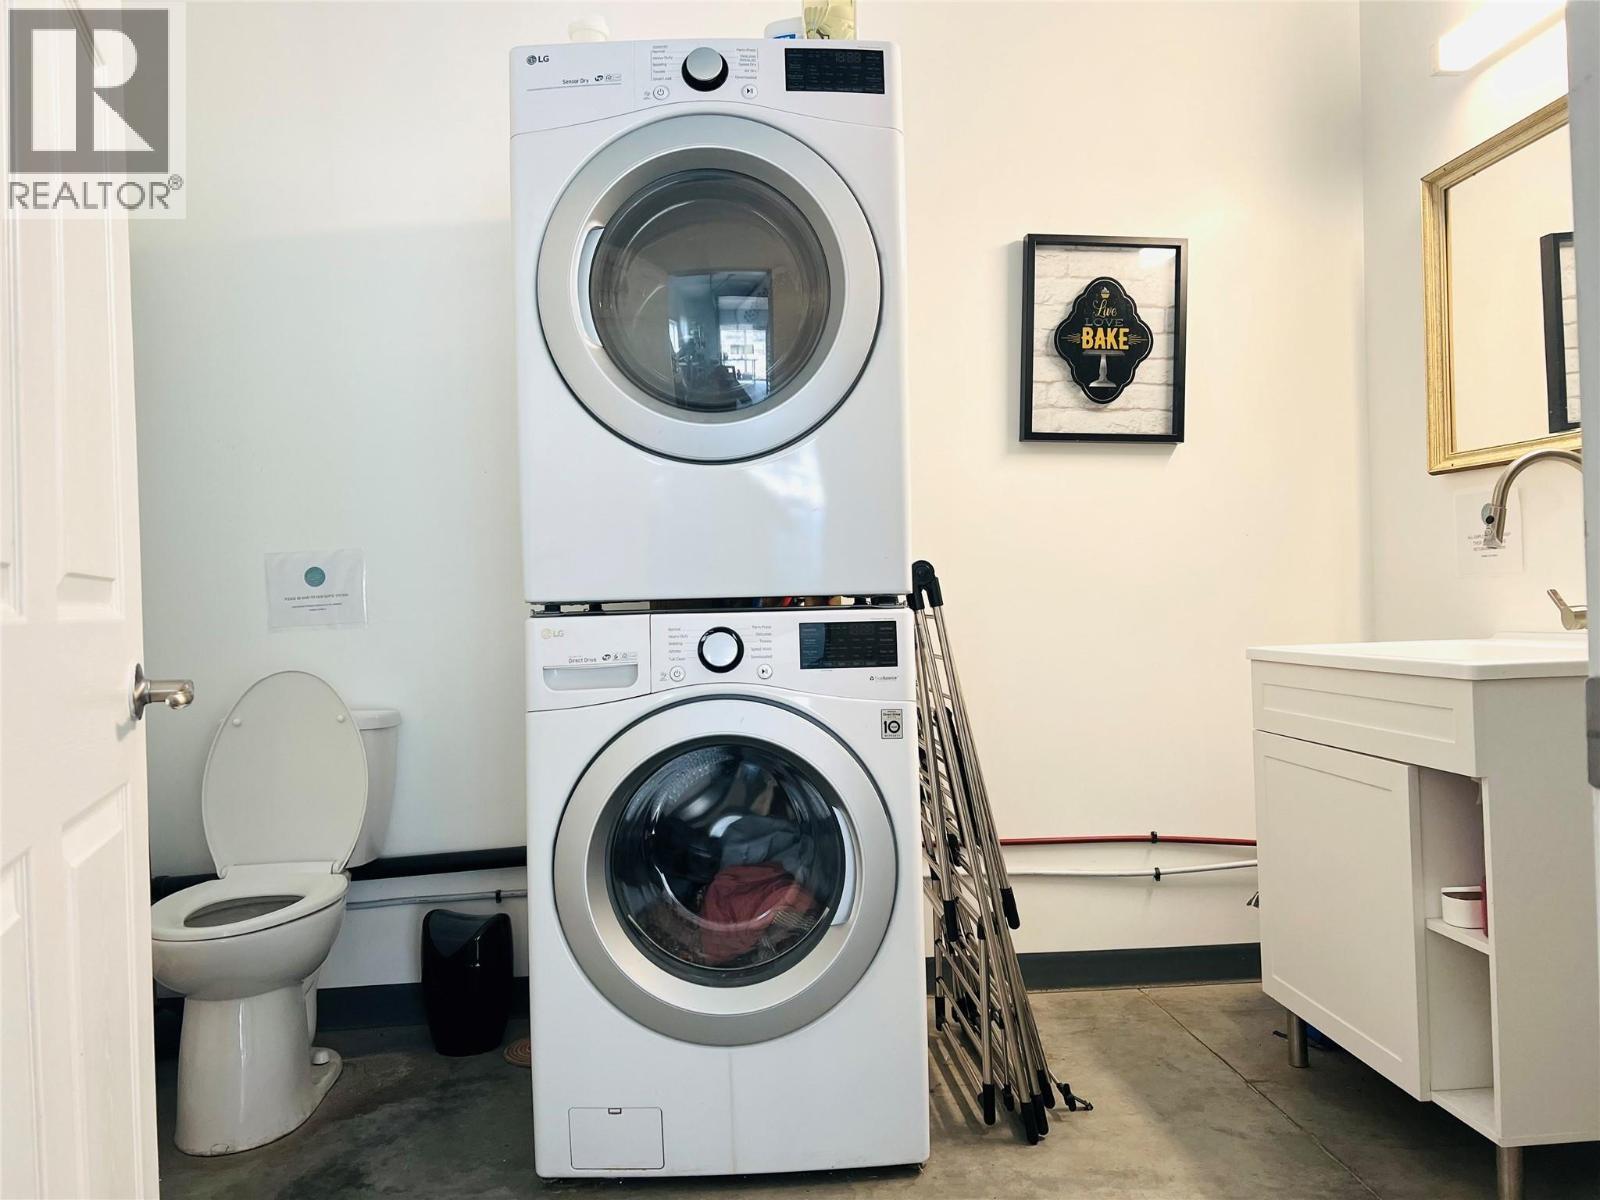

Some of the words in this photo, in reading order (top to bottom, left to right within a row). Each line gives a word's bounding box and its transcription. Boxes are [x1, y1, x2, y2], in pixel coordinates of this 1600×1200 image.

[538, 55, 550, 64] LG
[580, 77, 590, 85] Dry
[1092, 299, 1118, 318] Live
[1084, 318, 1124, 327] LOVE
[1081, 327, 1130, 350] BAKE
[883, 720, 901, 733] 10
